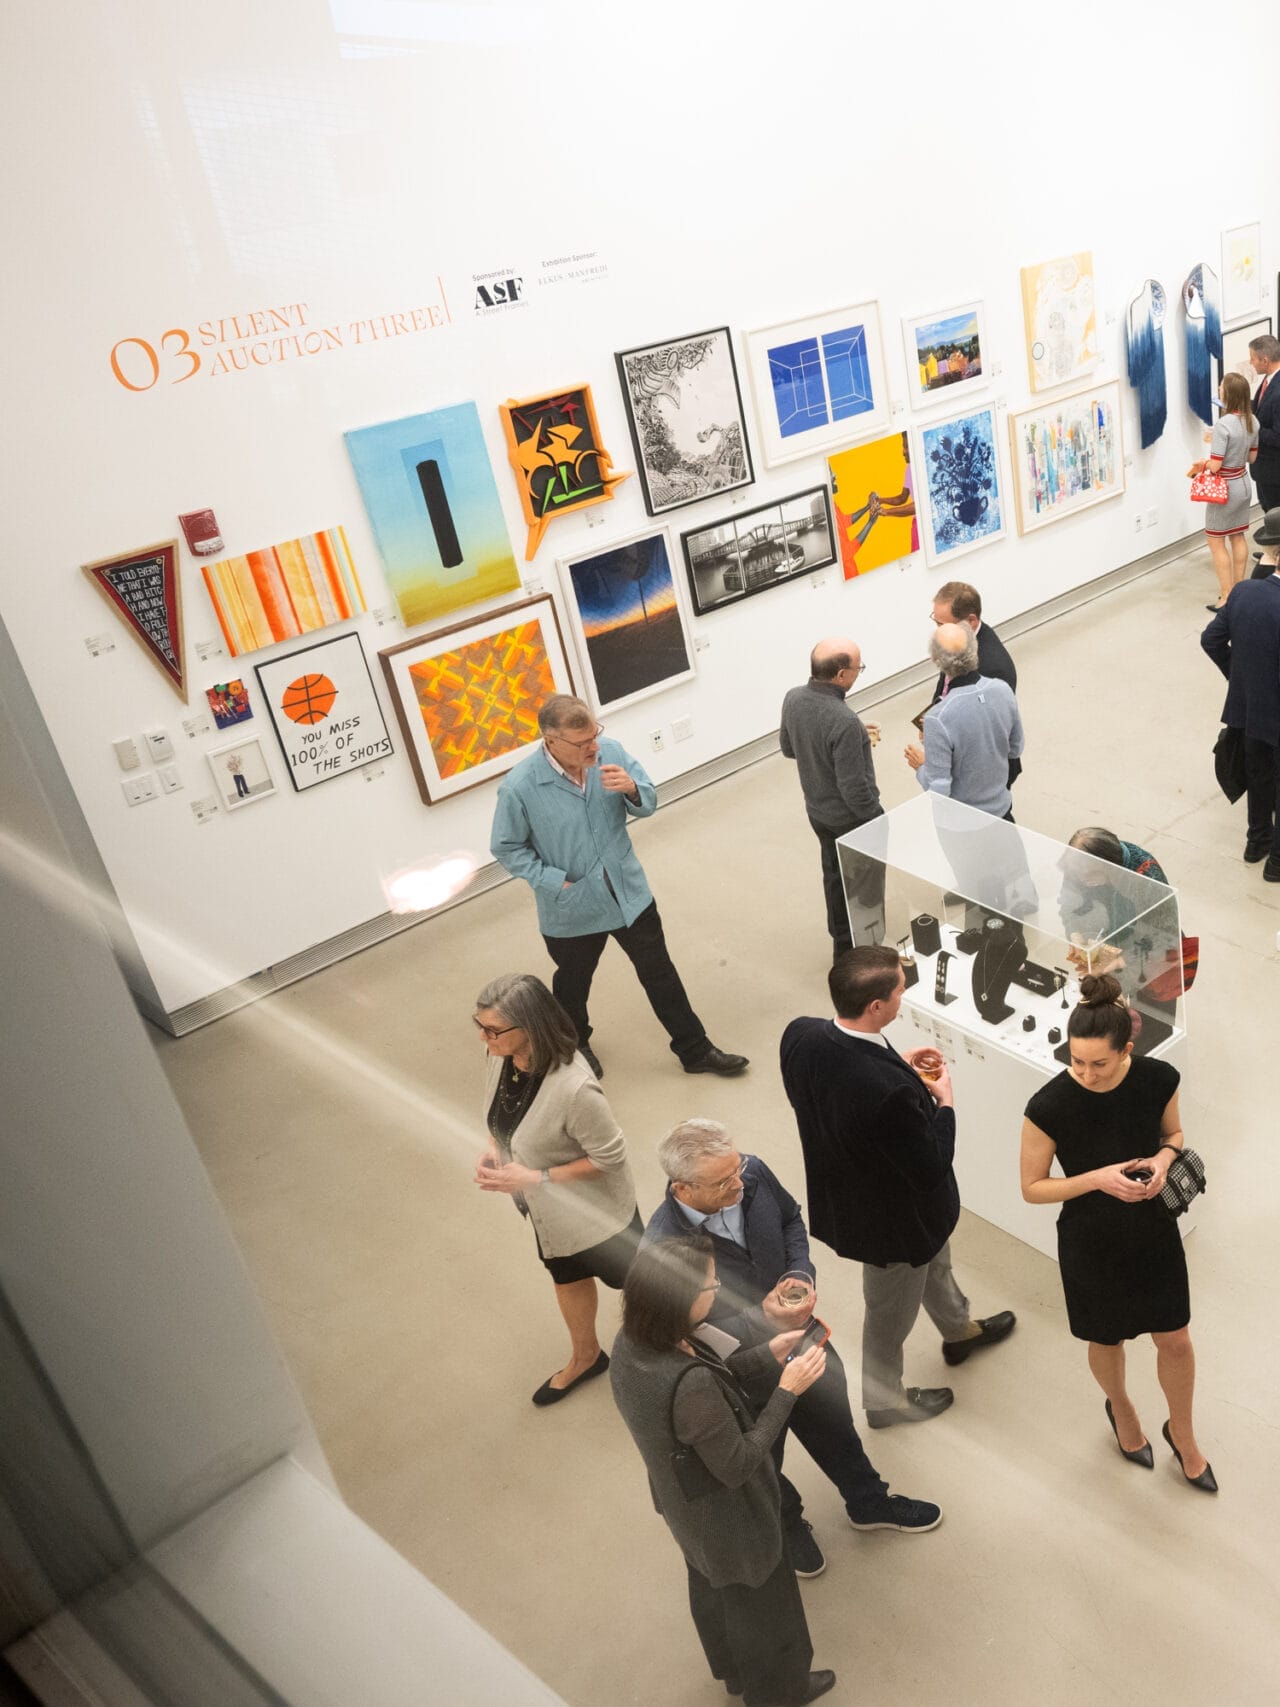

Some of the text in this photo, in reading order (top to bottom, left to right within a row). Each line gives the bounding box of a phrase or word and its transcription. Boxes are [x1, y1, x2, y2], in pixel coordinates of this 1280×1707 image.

[472, 269, 505, 281] Sponsored
[198, 303, 310, 346] SILENT
[210, 304, 444, 376] AUCTION THREE
[110, 328, 201, 392] 03
[119, 569, 136, 581] TOLD
[150, 575, 161, 586] WAS
[132, 591, 143, 601] BAD
[138, 599, 150, 610] AND
[301, 716, 360, 745] YOU MISS
[291, 732, 354, 767] 100% OF
[313, 755, 342, 775] THE
[350, 737, 390, 763] SHOTS
